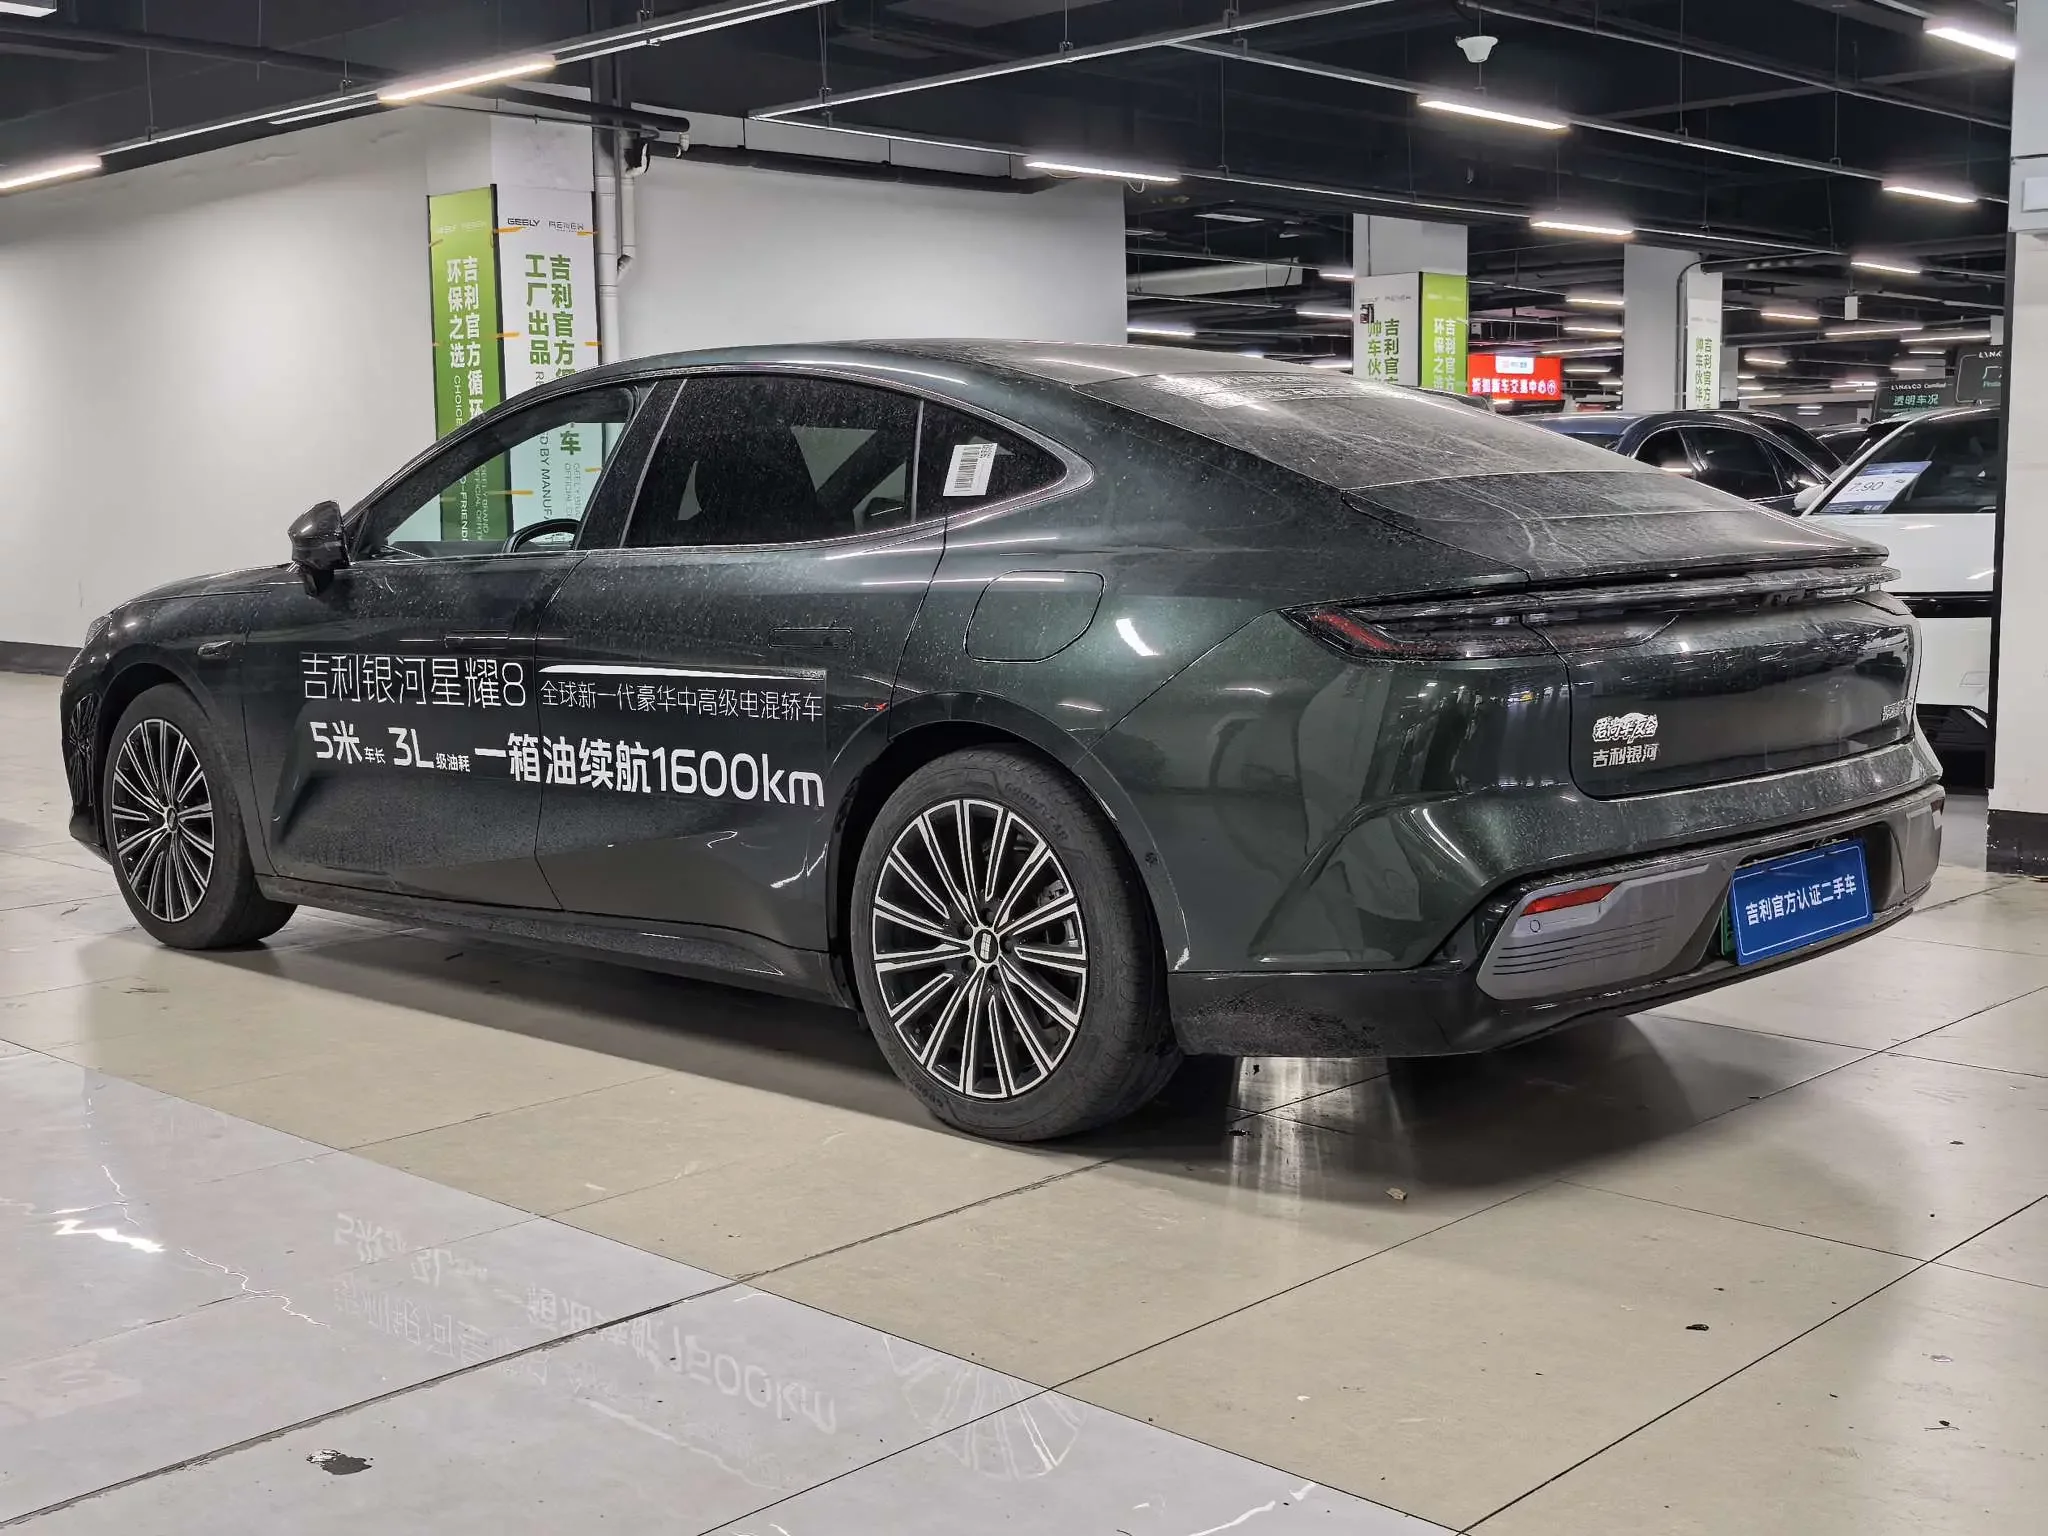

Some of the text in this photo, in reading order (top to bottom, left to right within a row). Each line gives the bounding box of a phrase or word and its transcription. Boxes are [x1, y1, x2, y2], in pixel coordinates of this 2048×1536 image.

[507, 217, 541, 227] GEELY
[446, 257, 465, 369] 环保之选
[525, 254, 551, 365] 工厂出品
[540, 448, 550, 466] BY
[301, 653, 526, 708] 吉利银河星耀8
[540, 680, 823, 722] 全球新一代豪华中高级电混轿车
[1592, 743, 1660, 768] 吉利银河
[1745, 873, 1857, 926] 吉利官方认证二手车
